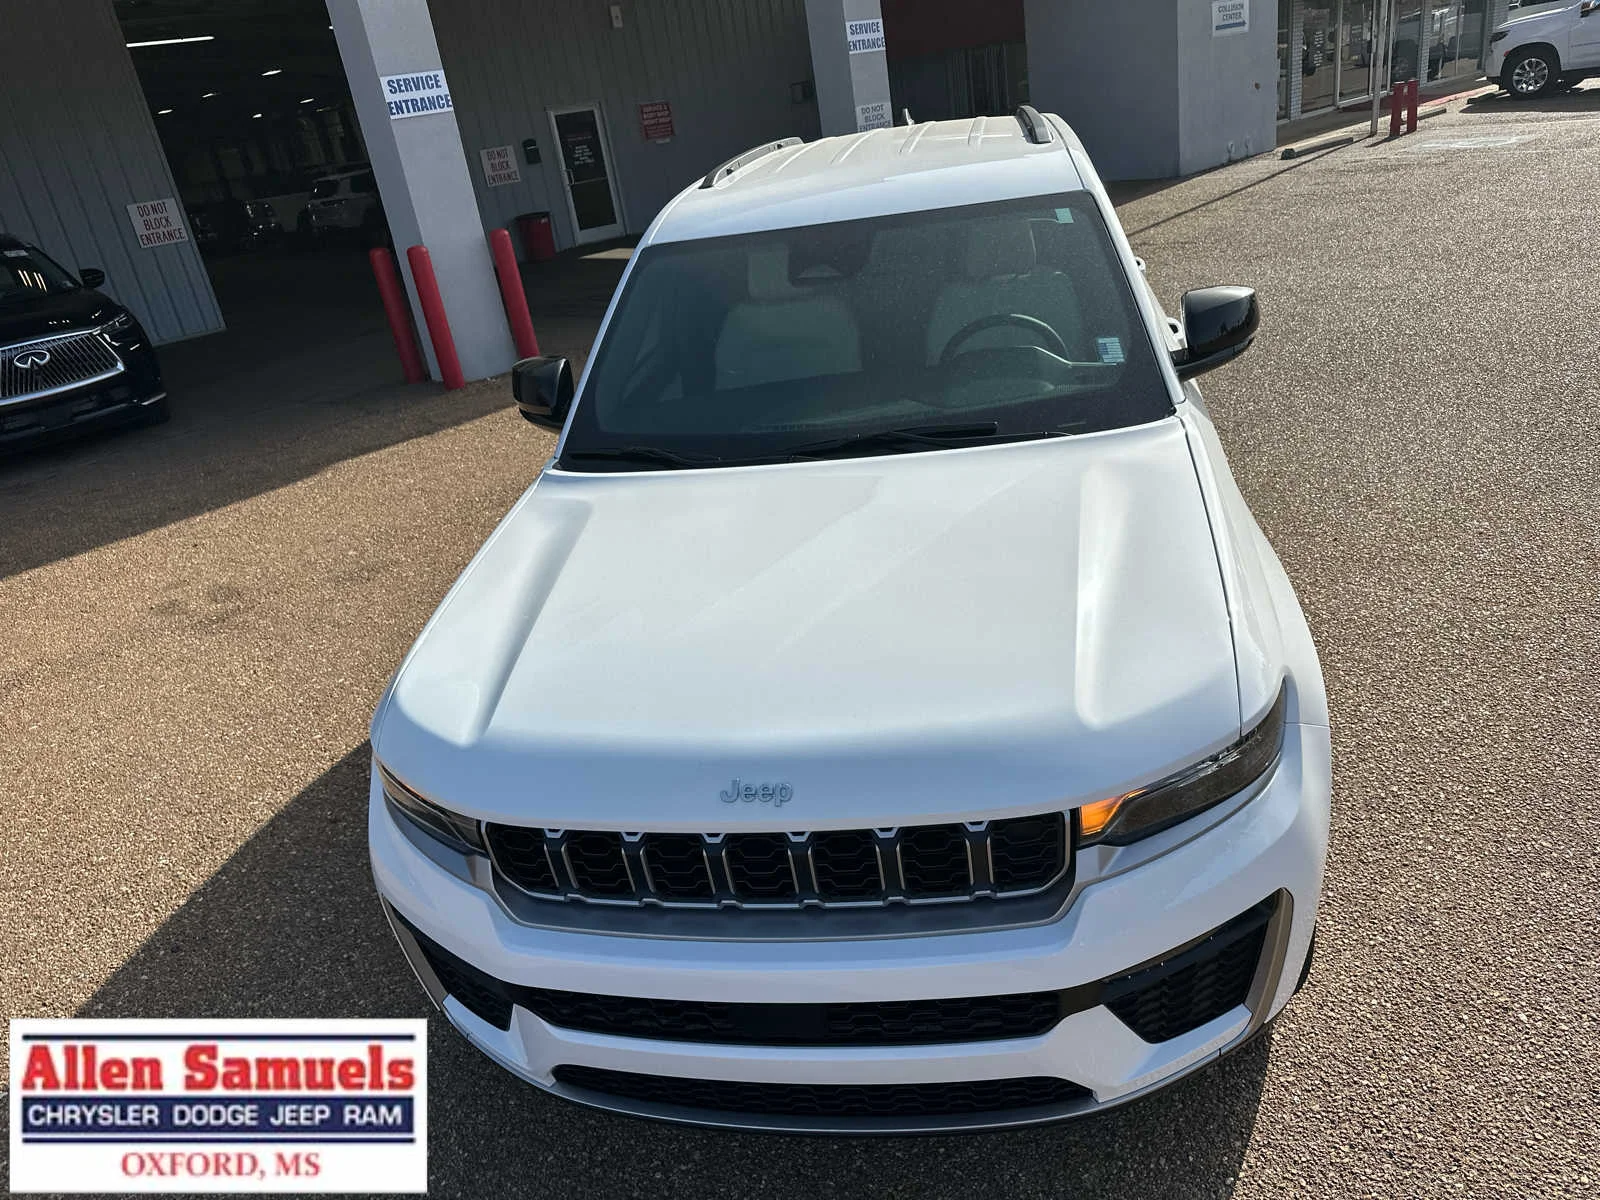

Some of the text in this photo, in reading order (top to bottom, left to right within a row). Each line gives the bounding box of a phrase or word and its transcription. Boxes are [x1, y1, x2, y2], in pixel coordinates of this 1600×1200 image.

[1222, 11, 1242, 21] CENTER
[849, 21, 880, 35] SERVICE
[849, 37, 885, 51] ENTRANCE
[386, 74, 442, 95] SERVICE
[387, 94, 453, 116] ENTRANCE
[861, 104, 884, 114] DO NOT
[864, 112, 885, 123] BLOCK
[487, 148, 509, 161] DO NOT
[491, 160, 511, 172] BLOCK
[487, 170, 520, 185] ENTRANCE
[137, 201, 168, 218] DO NOT
[143, 216, 172, 231] BLOCK
[140, 228, 185, 246] ENTRANCE
[719, 777, 794, 808] Jeep
